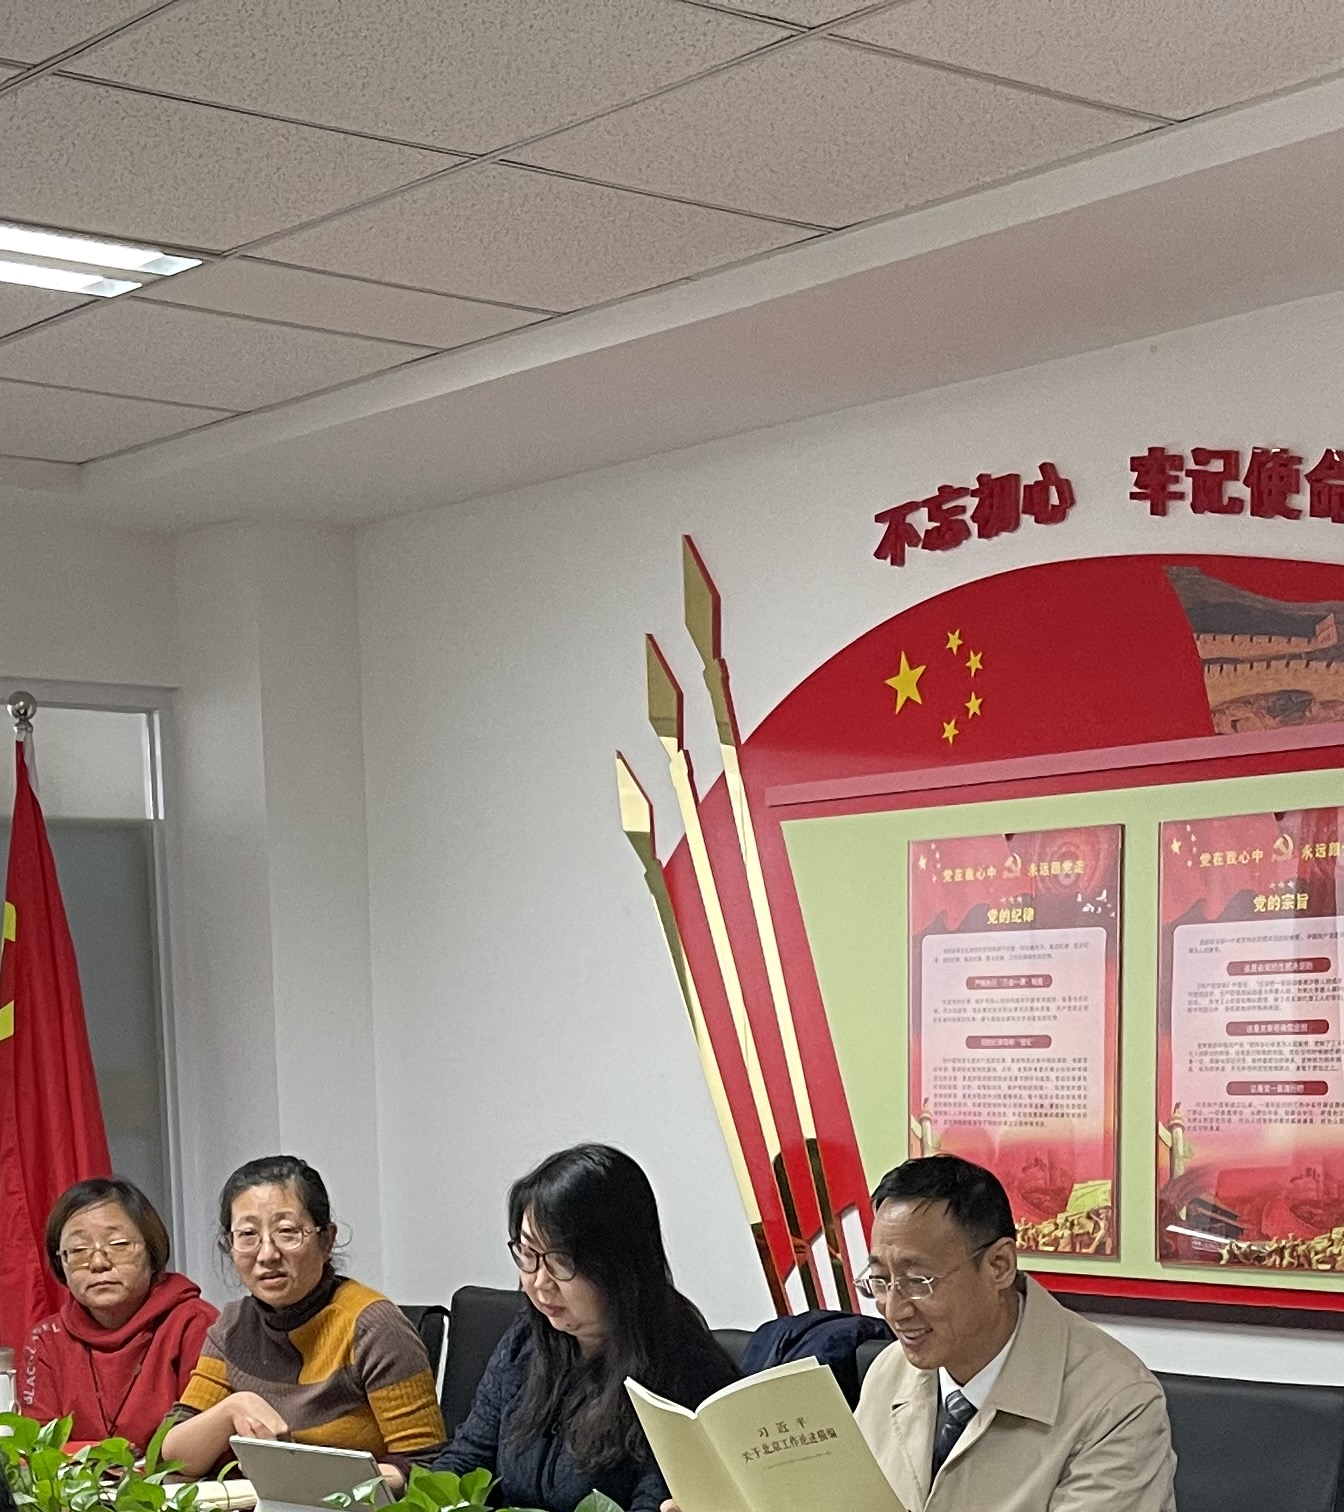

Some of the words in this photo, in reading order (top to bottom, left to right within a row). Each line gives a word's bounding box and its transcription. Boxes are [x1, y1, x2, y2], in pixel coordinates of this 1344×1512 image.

[873, 462, 1076, 567] 不忘初心
[1253, 893, 1309, 912] 党的宗旨
[987, 907, 1035, 924] 党的纪律
